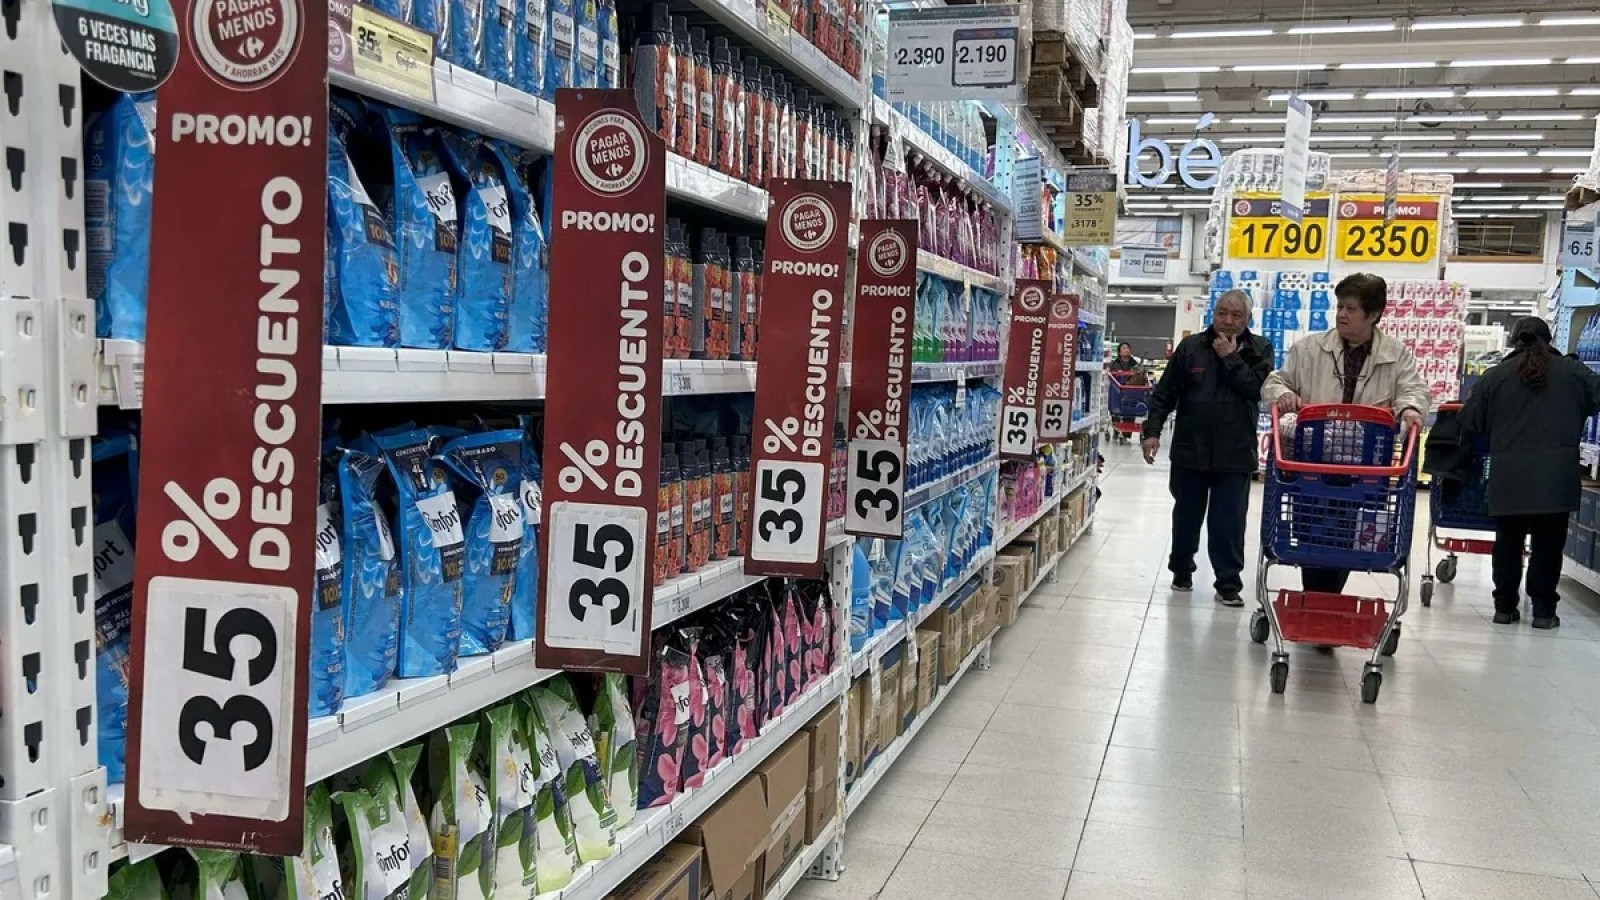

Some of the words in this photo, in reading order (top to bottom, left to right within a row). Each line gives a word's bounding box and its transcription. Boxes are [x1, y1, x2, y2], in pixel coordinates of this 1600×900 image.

[78, 17, 88, 36] 6
[89, 19, 128, 45] VECES
[130, 29, 156, 52] MÁS
[218, 7, 277, 40] MENOS
[231, 63, 269, 78] AHORRAR
[171, 113, 313, 146] PROMO!
[590, 131, 627, 152] PAGAR
[591, 144, 631, 166] MENOS
[1128, 112, 1221, 189] bé
[561, 210, 656, 233] PROMO!
[793, 209, 821, 221] PAGAR
[794, 219, 823, 231] MENOS
[1242, 223, 1322, 255] 1790
[1347, 225, 1429, 258] 2350
[771, 260, 840, 278] PROMO!
[860, 284, 911, 297] PROMO!
[1014, 315, 1046, 324] PROMO!
[249, 176, 303, 571] DESCUENTO
[614, 251, 650, 498] DESCUENTO
[802, 289, 833, 457] DESCUENTO
[884, 306, 908, 442] DESCUENTO
[1025, 328, 1043, 406] DESCUENTO
[1060, 332, 1074, 399] DESCUENTO
[1008, 386, 1025, 405] %
[1045, 382, 1061, 398] %
[855, 408, 884, 440] %
[1007, 411, 1030, 446] 35
[1044, 403, 1064, 432] 35
[763, 416, 800, 454] %
[558, 439, 610, 494] %
[854, 449, 902, 523] 35
[160, 476, 241, 562] %
[758, 468, 807, 545] 35
[568, 523, 635, 627] 35
[178, 606, 278, 772] 35
